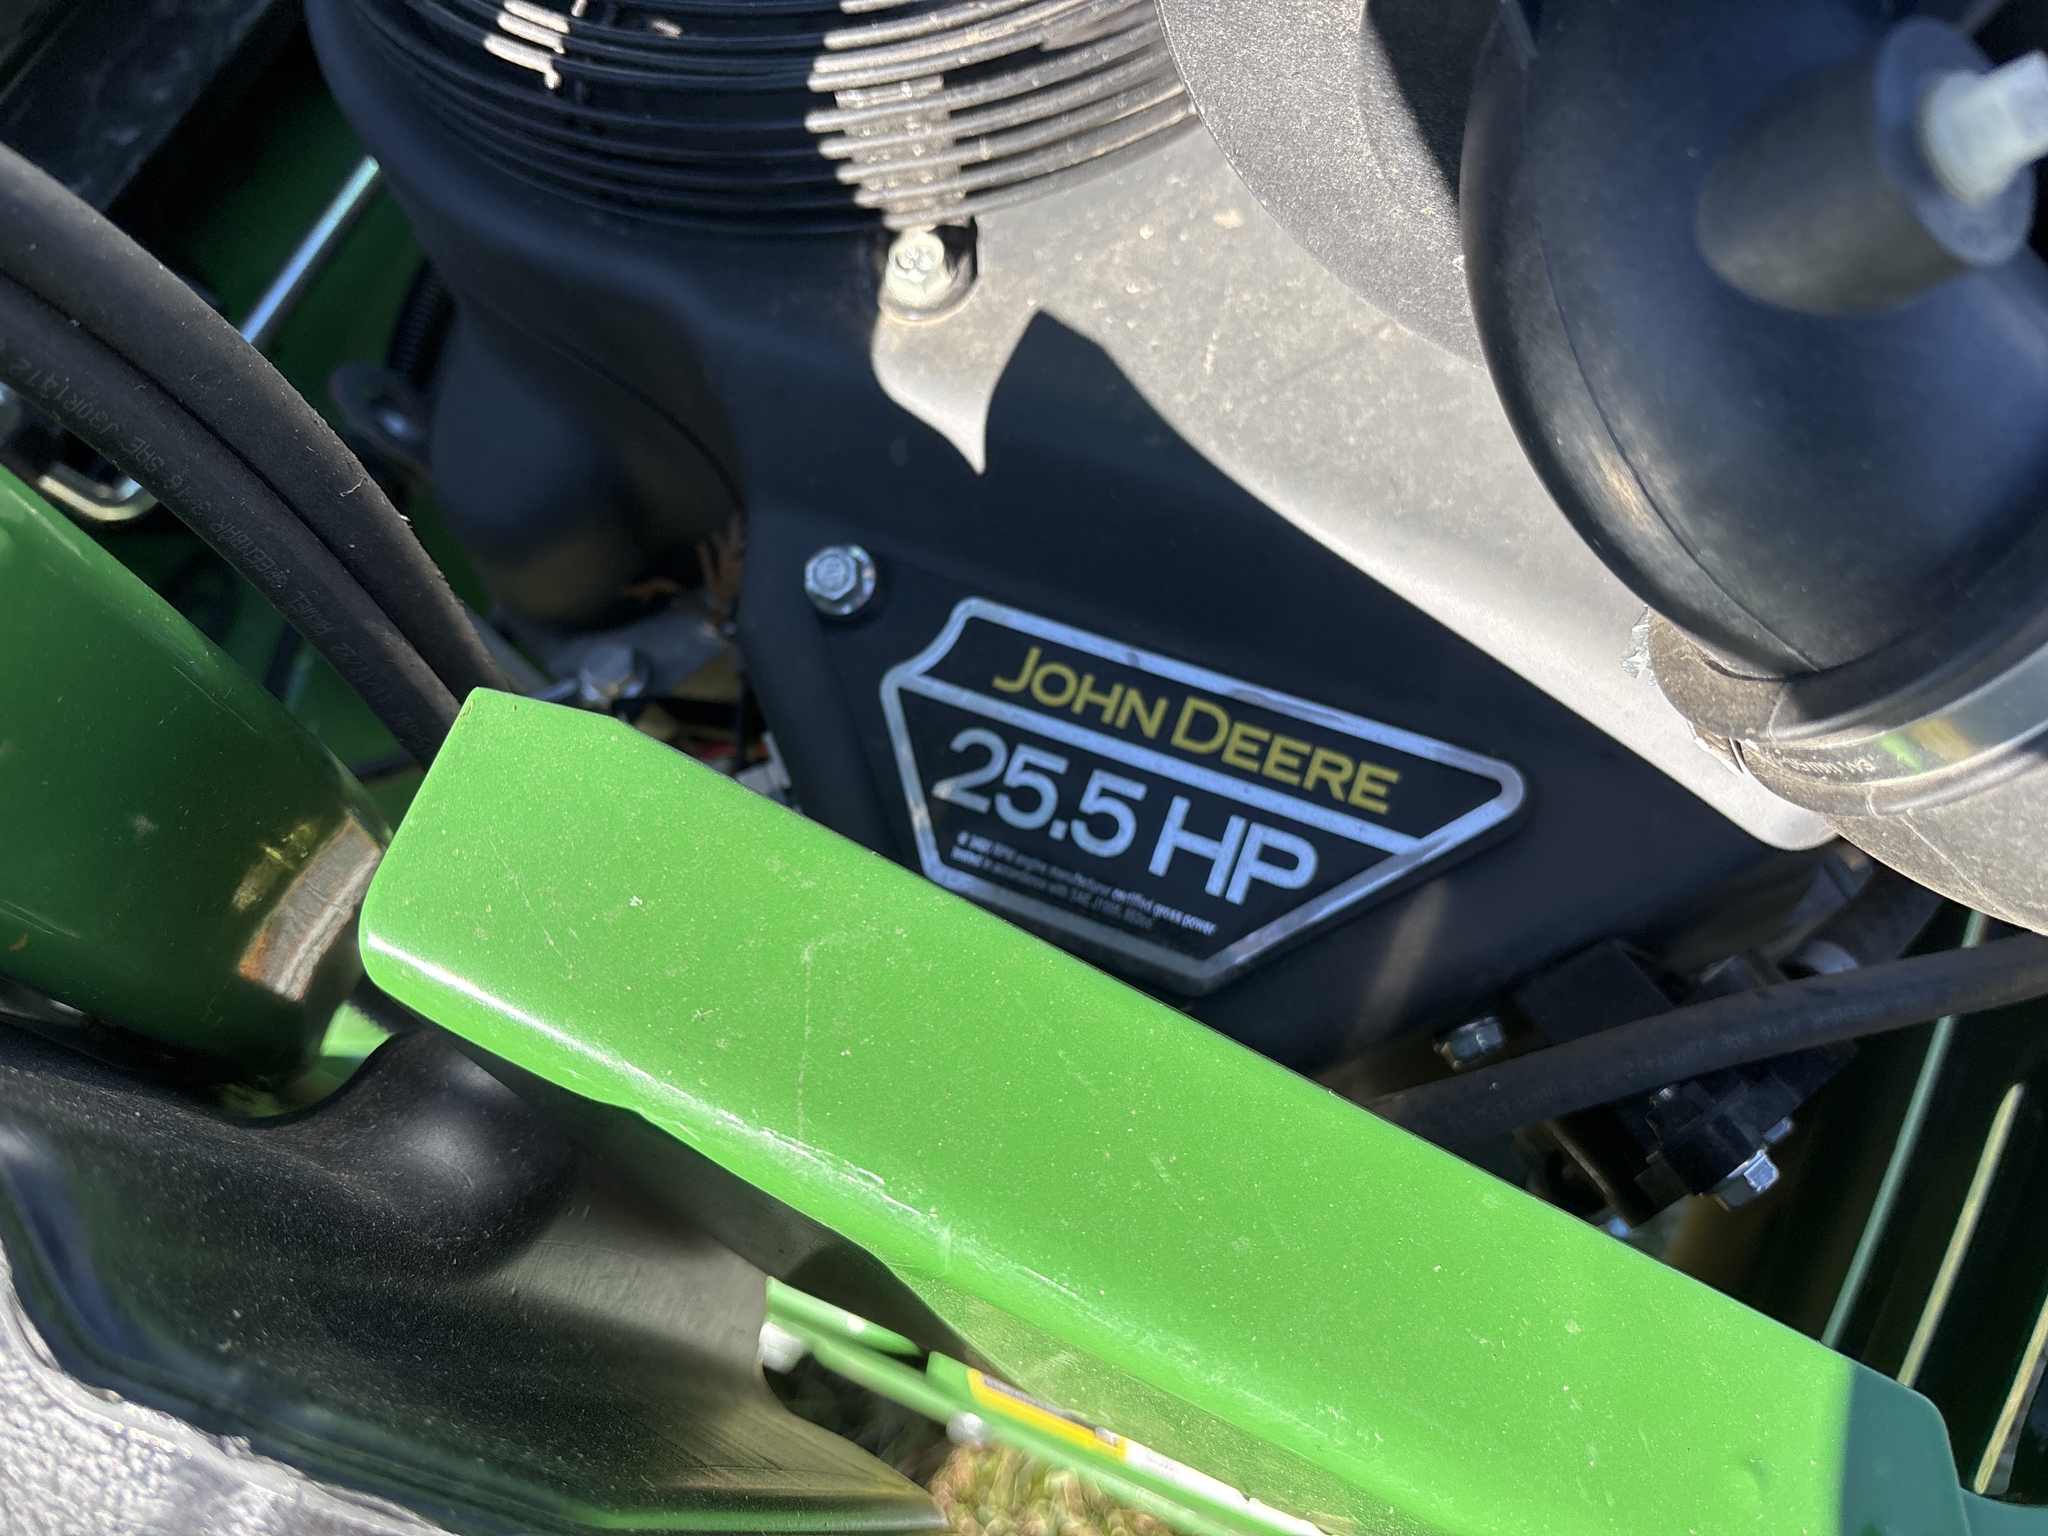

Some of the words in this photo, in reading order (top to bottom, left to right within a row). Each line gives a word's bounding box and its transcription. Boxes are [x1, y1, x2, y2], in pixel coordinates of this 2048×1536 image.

[123, 436, 163, 466] SAE
[993, 647, 1169, 738] JOHN
[1170, 697, 1401, 815] DEERE
[932, 727, 1147, 859] 25.5
[1148, 797, 1318, 906] HP
[1111, 886, 1155, 912] certified
[1152, 902, 1184, 923] gross
